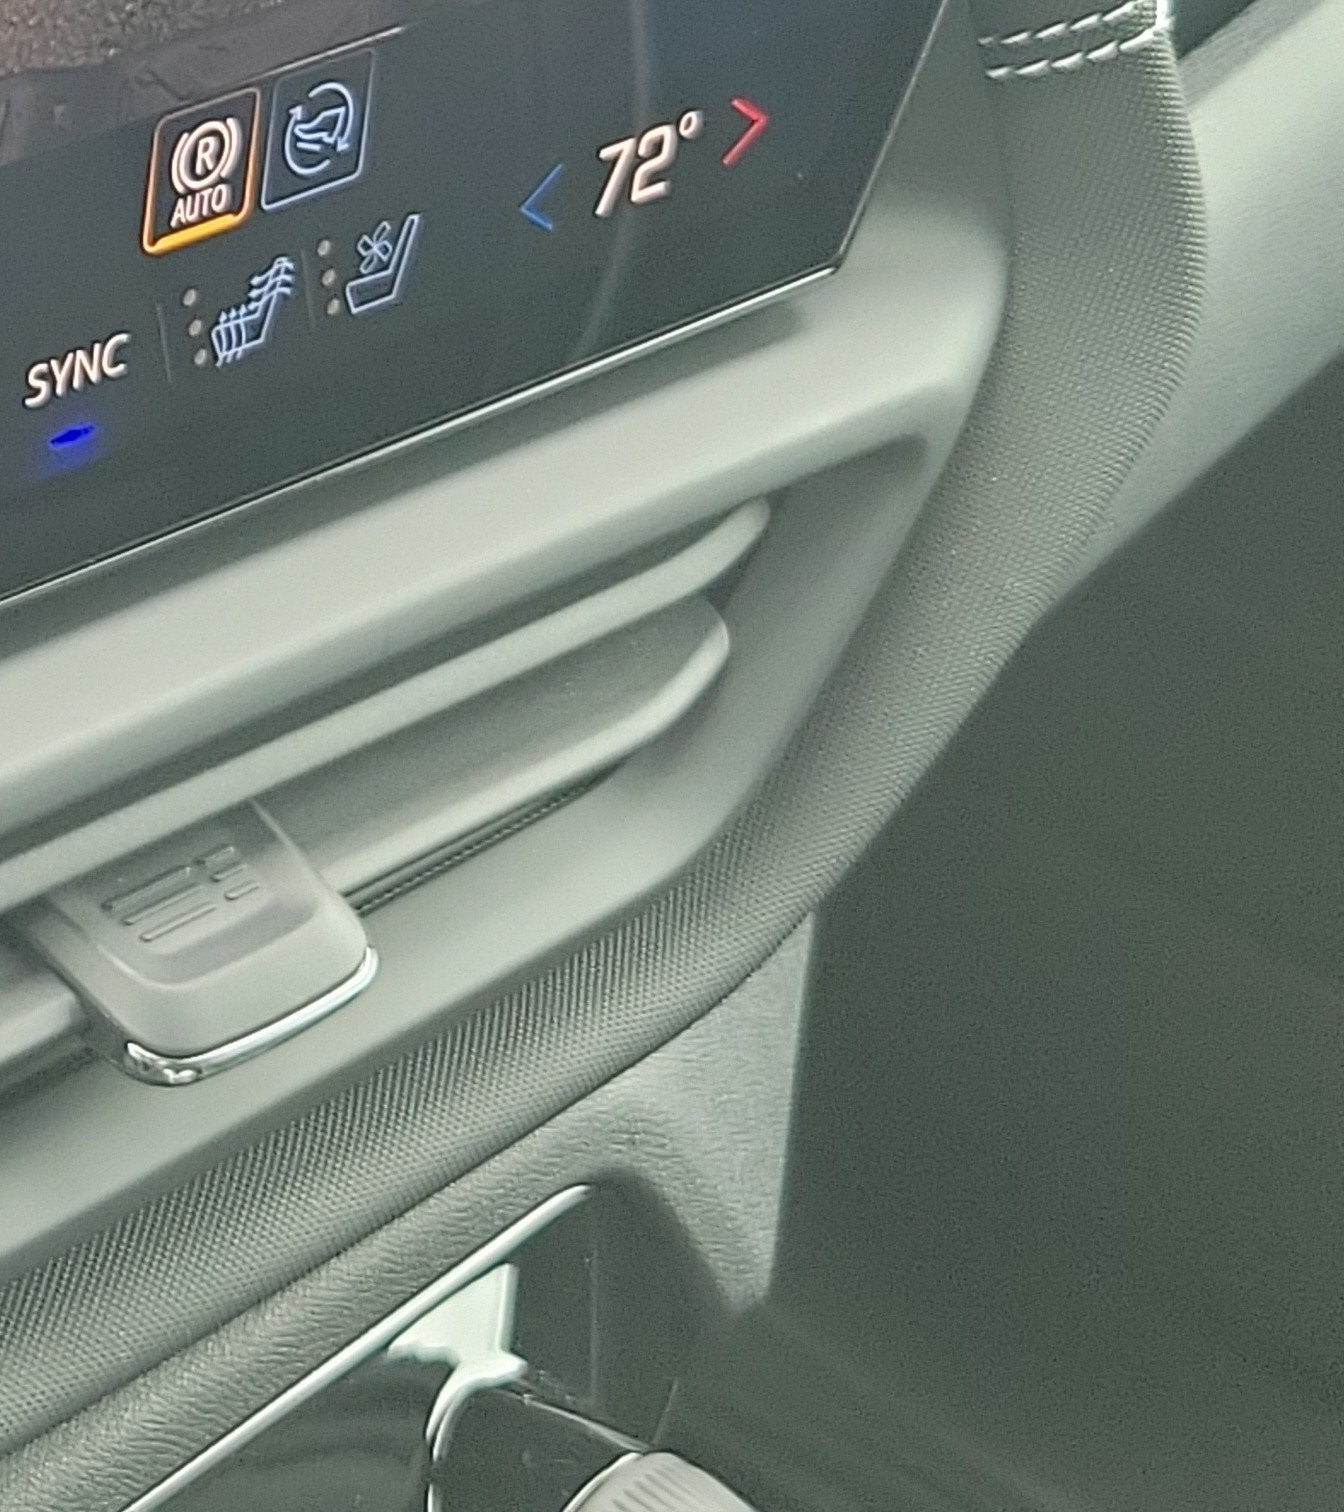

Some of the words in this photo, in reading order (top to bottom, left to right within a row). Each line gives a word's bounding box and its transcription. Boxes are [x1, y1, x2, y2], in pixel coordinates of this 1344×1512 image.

[194, 138, 214, 174] R
[596, 110, 703, 218] 72°
[170, 185, 229, 226] AUTO
[23, 333, 131, 408] SYNC
